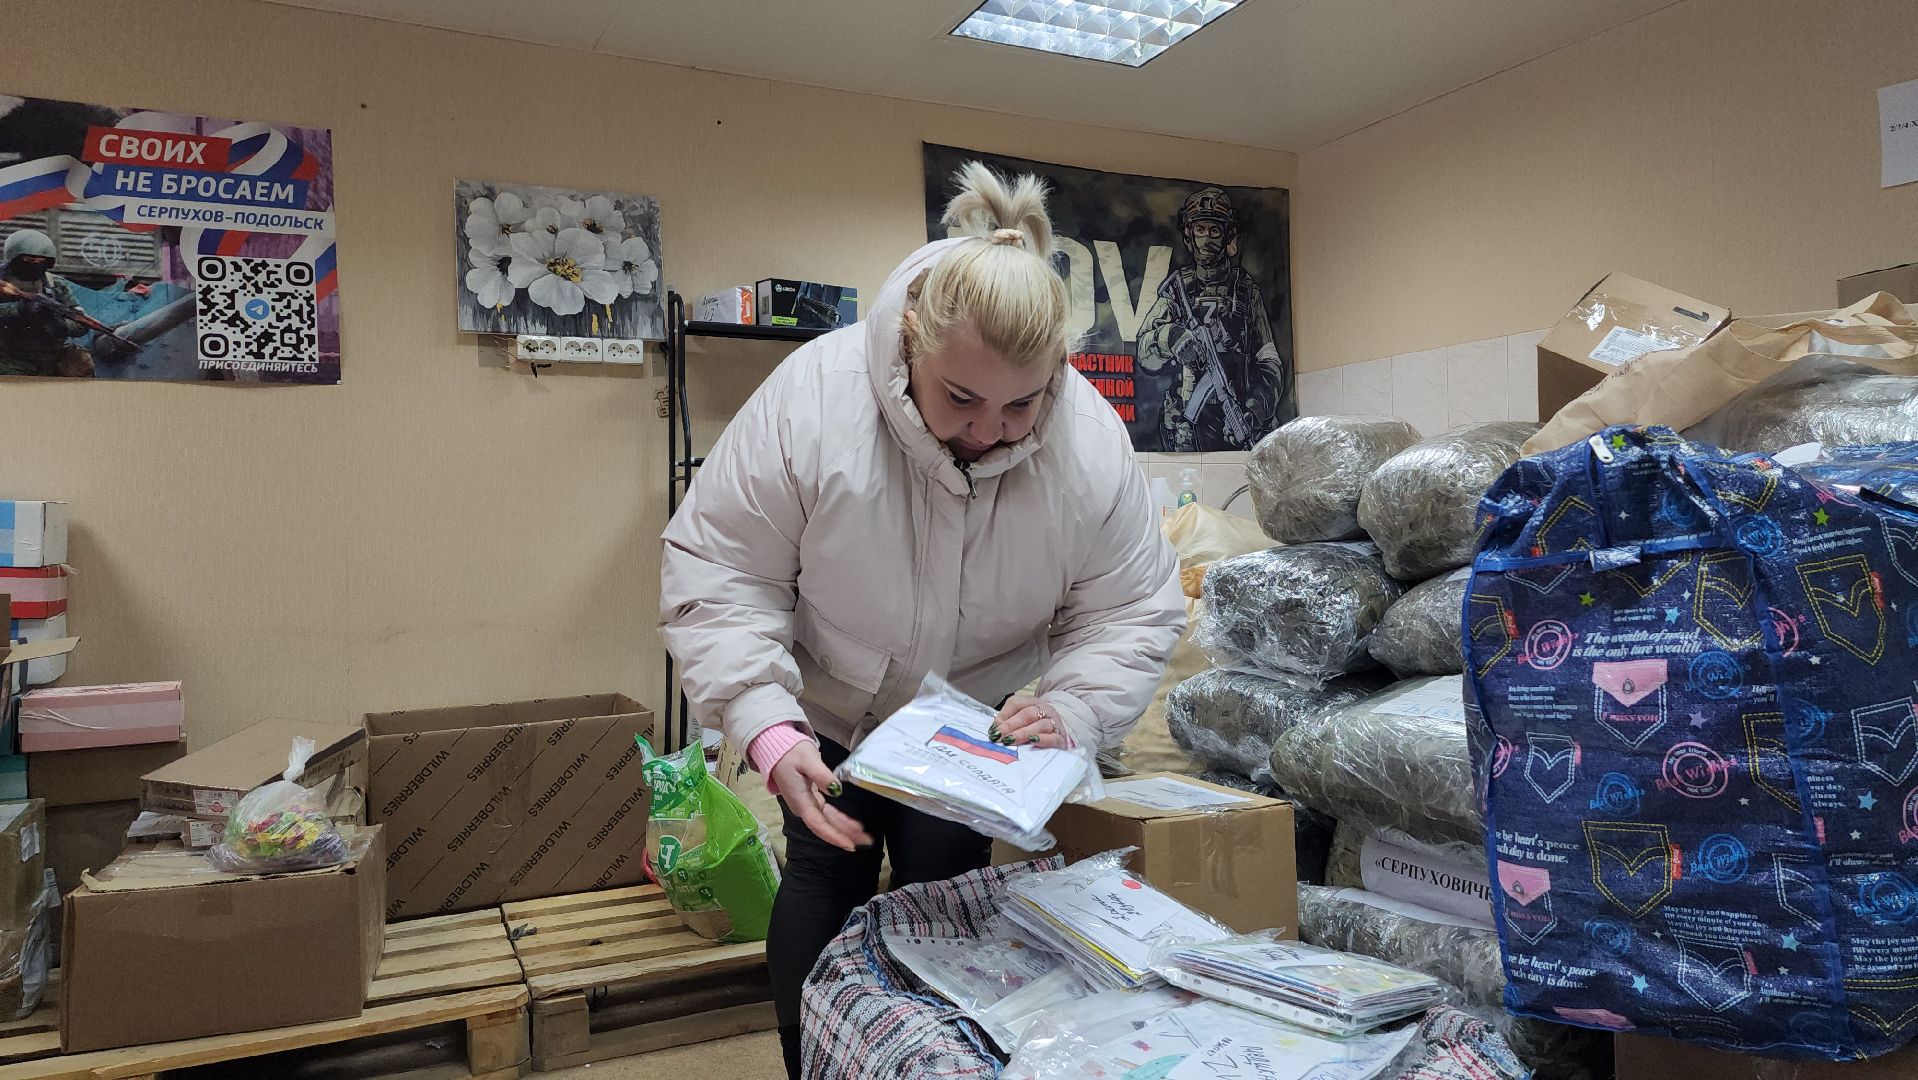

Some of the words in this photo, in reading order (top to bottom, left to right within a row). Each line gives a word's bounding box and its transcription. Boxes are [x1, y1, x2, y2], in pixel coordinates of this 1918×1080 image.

[99, 134, 207, 164] СВОИХ
[115, 170, 153, 193] НЕ
[161, 174, 295, 203] БРОСАЕМ
[136, 204, 324, 231] СЕРПУХОВ-ПОДОЛЬСК
[1068, 353, 1134, 373] ЧАСТНИК
[1572, 646, 1582, 657] is
[1583, 645, 1604, 657] the
[1605, 644, 1629, 658] only
[1584, 632, 1610, 644] The
[383, 750, 450, 817] WILDBERRIES
[527, 752, 590, 818] WILDBERRIES
[447, 786, 513, 852] WILDBERRIES
[586, 787, 646, 850] WILDBERRIES
[386, 827, 427, 873] WILDBE
[509, 820, 572, 887] WILDBERRIES
[1502, 830, 1513, 842] be
[1515, 831, 1544, 847] heart's
[1546, 840, 1580, 851] peace
[1509, 844, 1524, 857] day
[1526, 848, 1534, 859] is
[1518, 954, 1529, 966] be
[1531, 955, 1567, 974] heart's
[1569, 966, 1597, 977] peace
[1528, 969, 1544, 986] day
[1547, 974, 1556, 986] is
